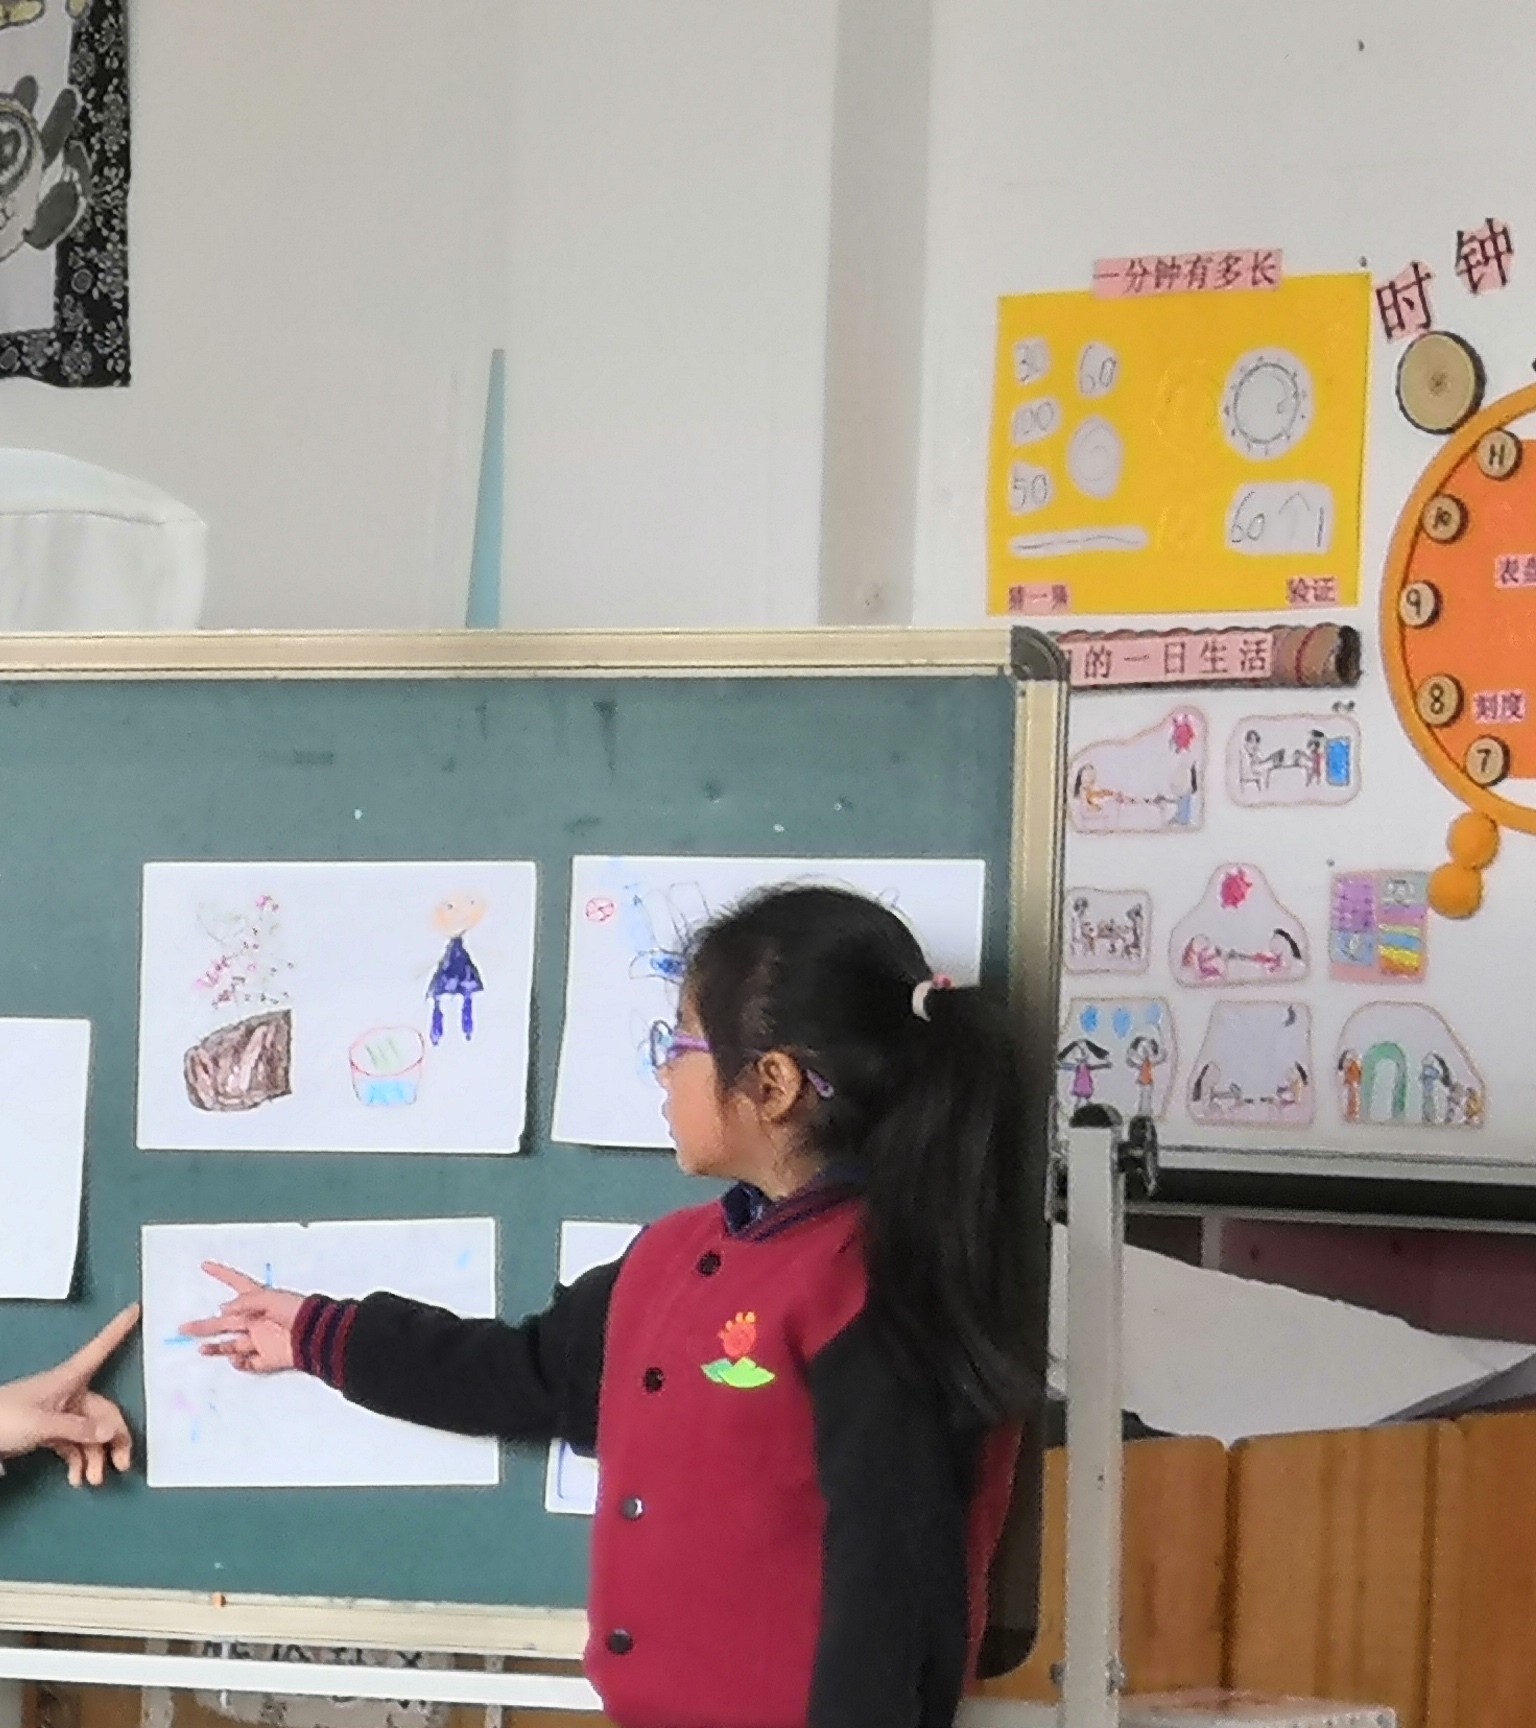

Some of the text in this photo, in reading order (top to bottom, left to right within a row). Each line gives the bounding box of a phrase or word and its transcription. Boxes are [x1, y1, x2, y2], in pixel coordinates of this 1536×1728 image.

[1093, 251, 1277, 295] 一分钟有多长
[1376, 217, 1514, 340] 时钟
[1406, 588, 1422, 617] 9
[1064, 638, 1267, 679] 的一日生活
[1430, 683, 1445, 715] 8
[1476, 748, 1492, 773] 7
